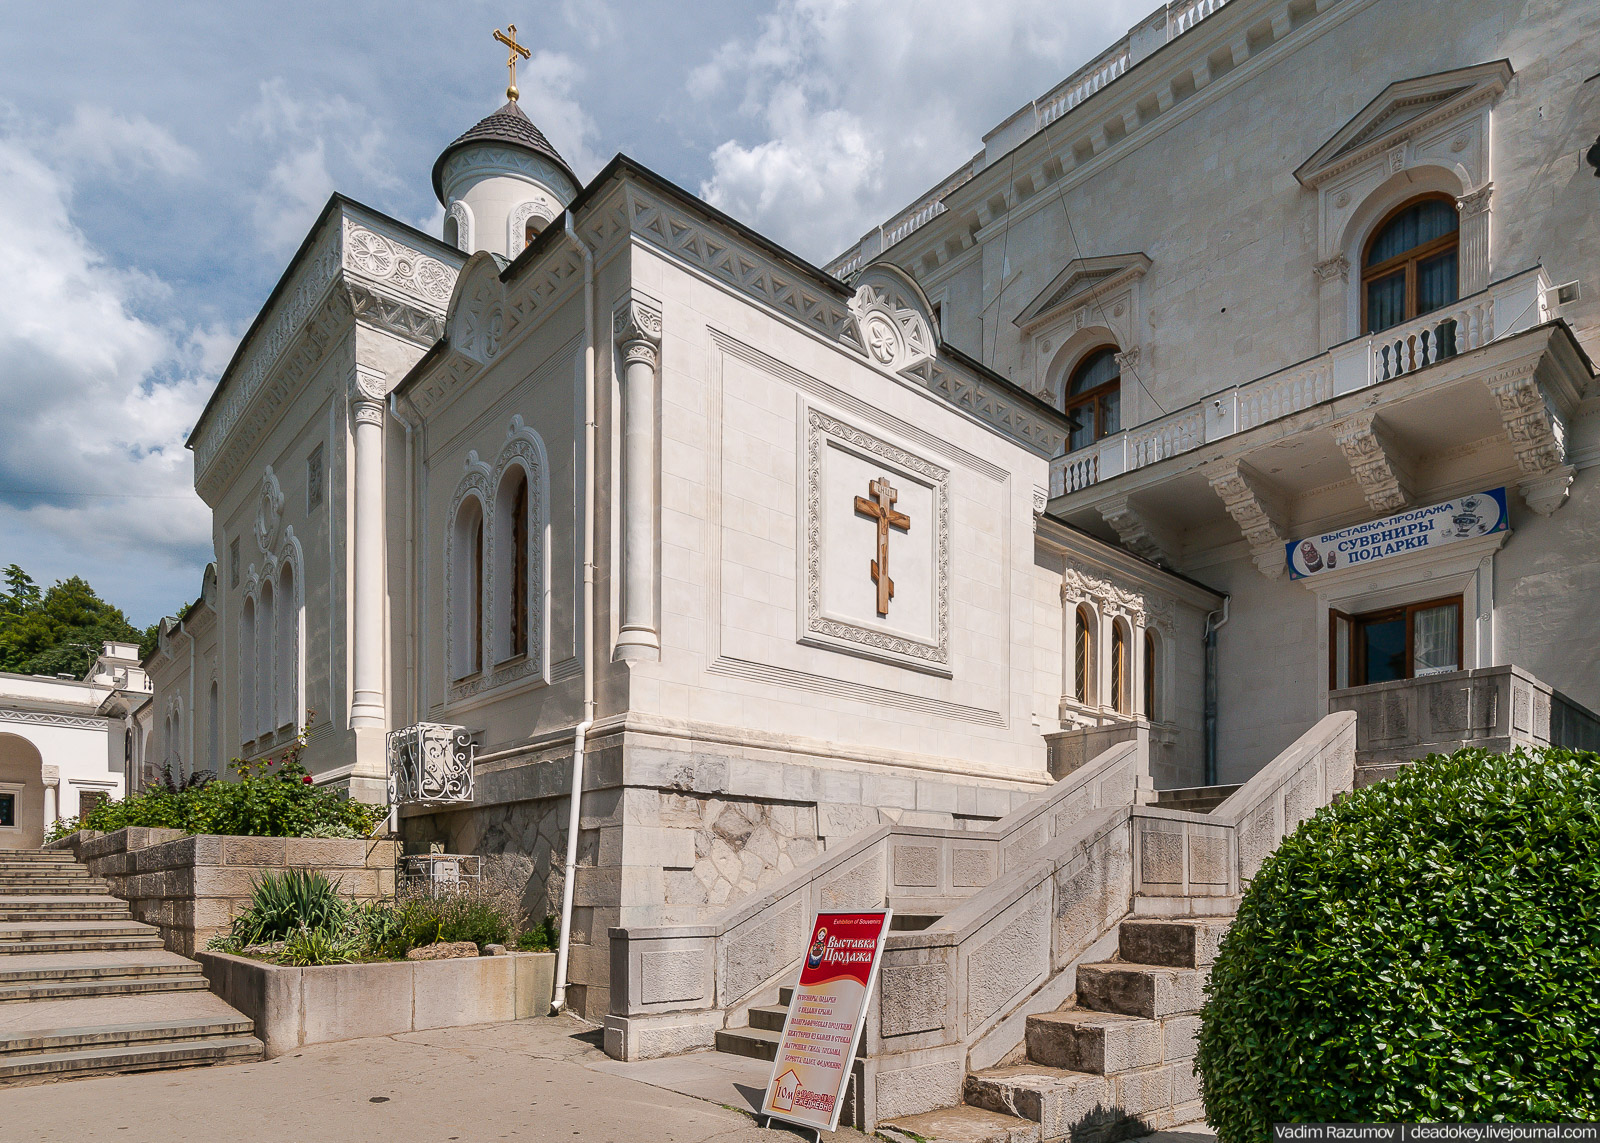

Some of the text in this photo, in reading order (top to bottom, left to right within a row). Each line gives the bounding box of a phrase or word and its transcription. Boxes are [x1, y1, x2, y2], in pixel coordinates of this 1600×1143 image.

[1320, 503, 1454, 543] ВЫСТАВКА-ПРОДАЖА
[1337, 518, 1435, 552] СУВЕНИРЫ
[1347, 534, 1429, 563] ПОДАРКИ
[828, 935, 875, 949] Выставка
[823, 948, 872, 965] Продажа
[794, 1098, 833, 1112] ЕЖЕДНЕВНО
